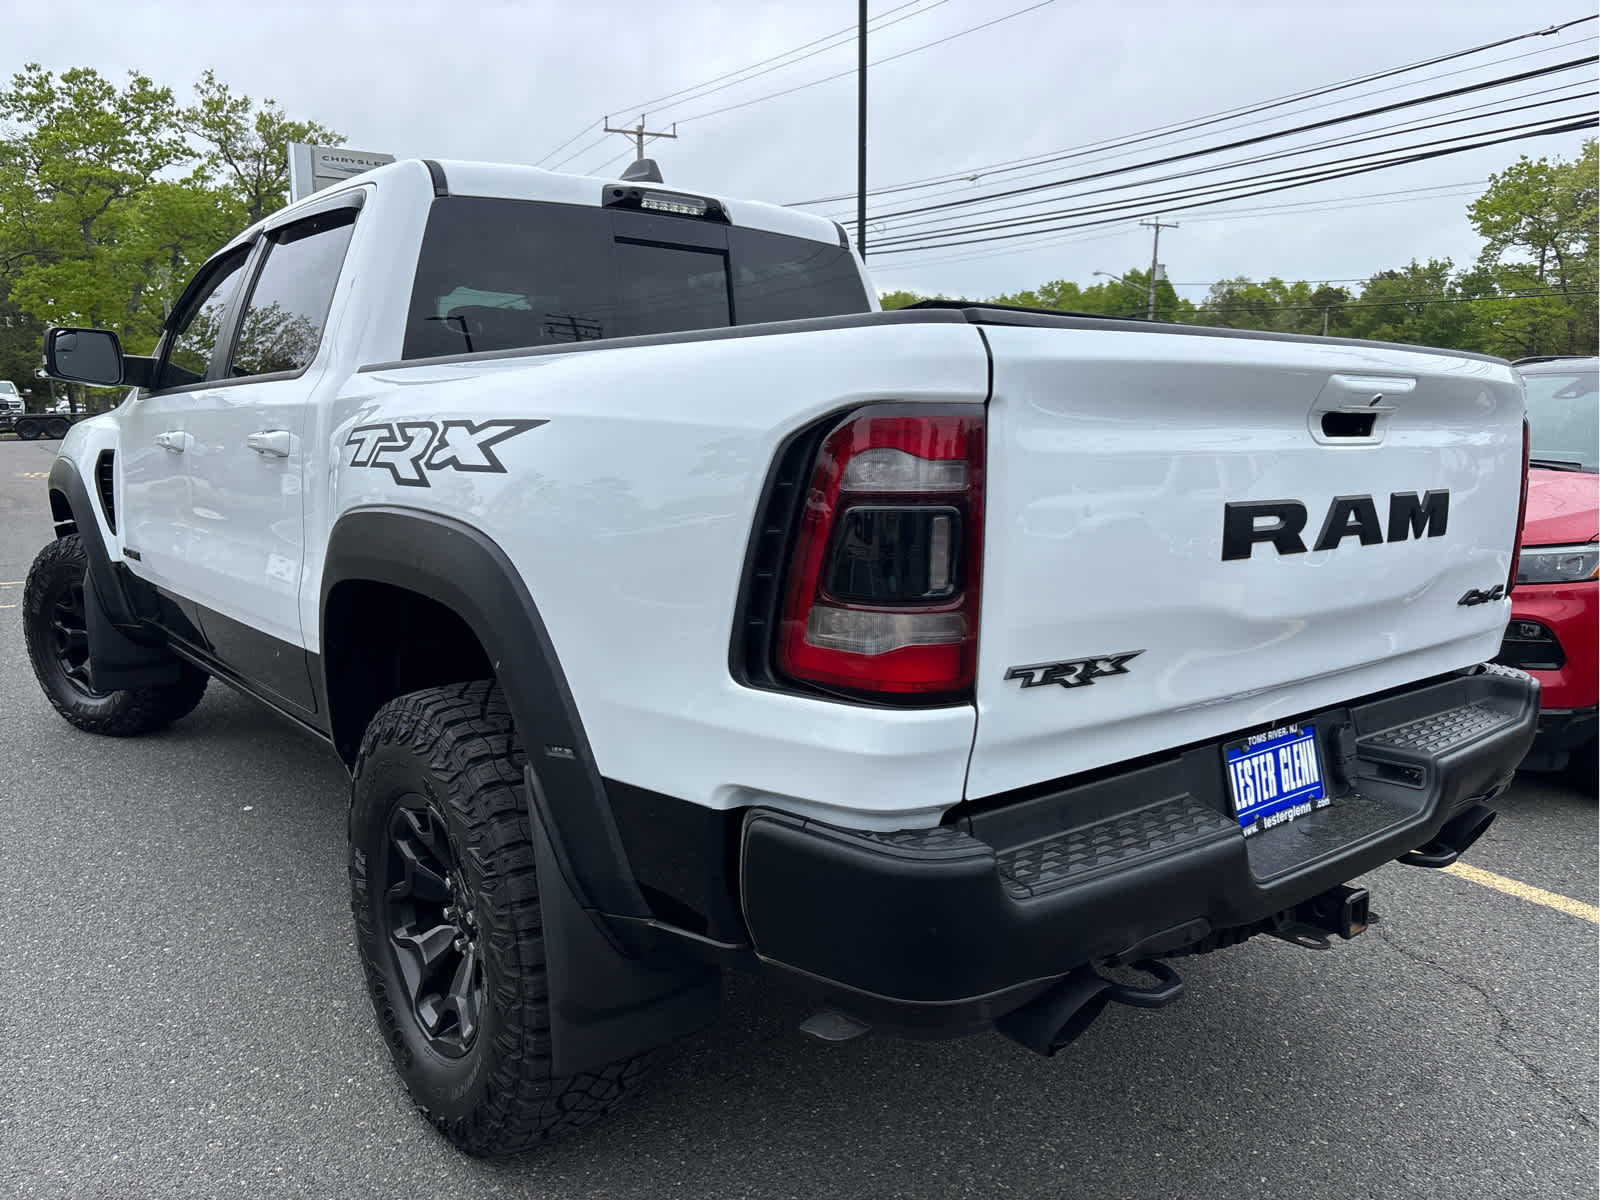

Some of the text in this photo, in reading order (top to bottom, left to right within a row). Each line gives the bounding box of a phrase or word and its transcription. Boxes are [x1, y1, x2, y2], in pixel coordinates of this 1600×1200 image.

[345, 419, 551, 487] TRX
[1221, 488, 1450, 561] RAM
[1003, 649, 1147, 688] TRX
[1229, 739, 1319, 811] LESTER GLENN
[1263, 802, 1312, 829] lesterglenn
